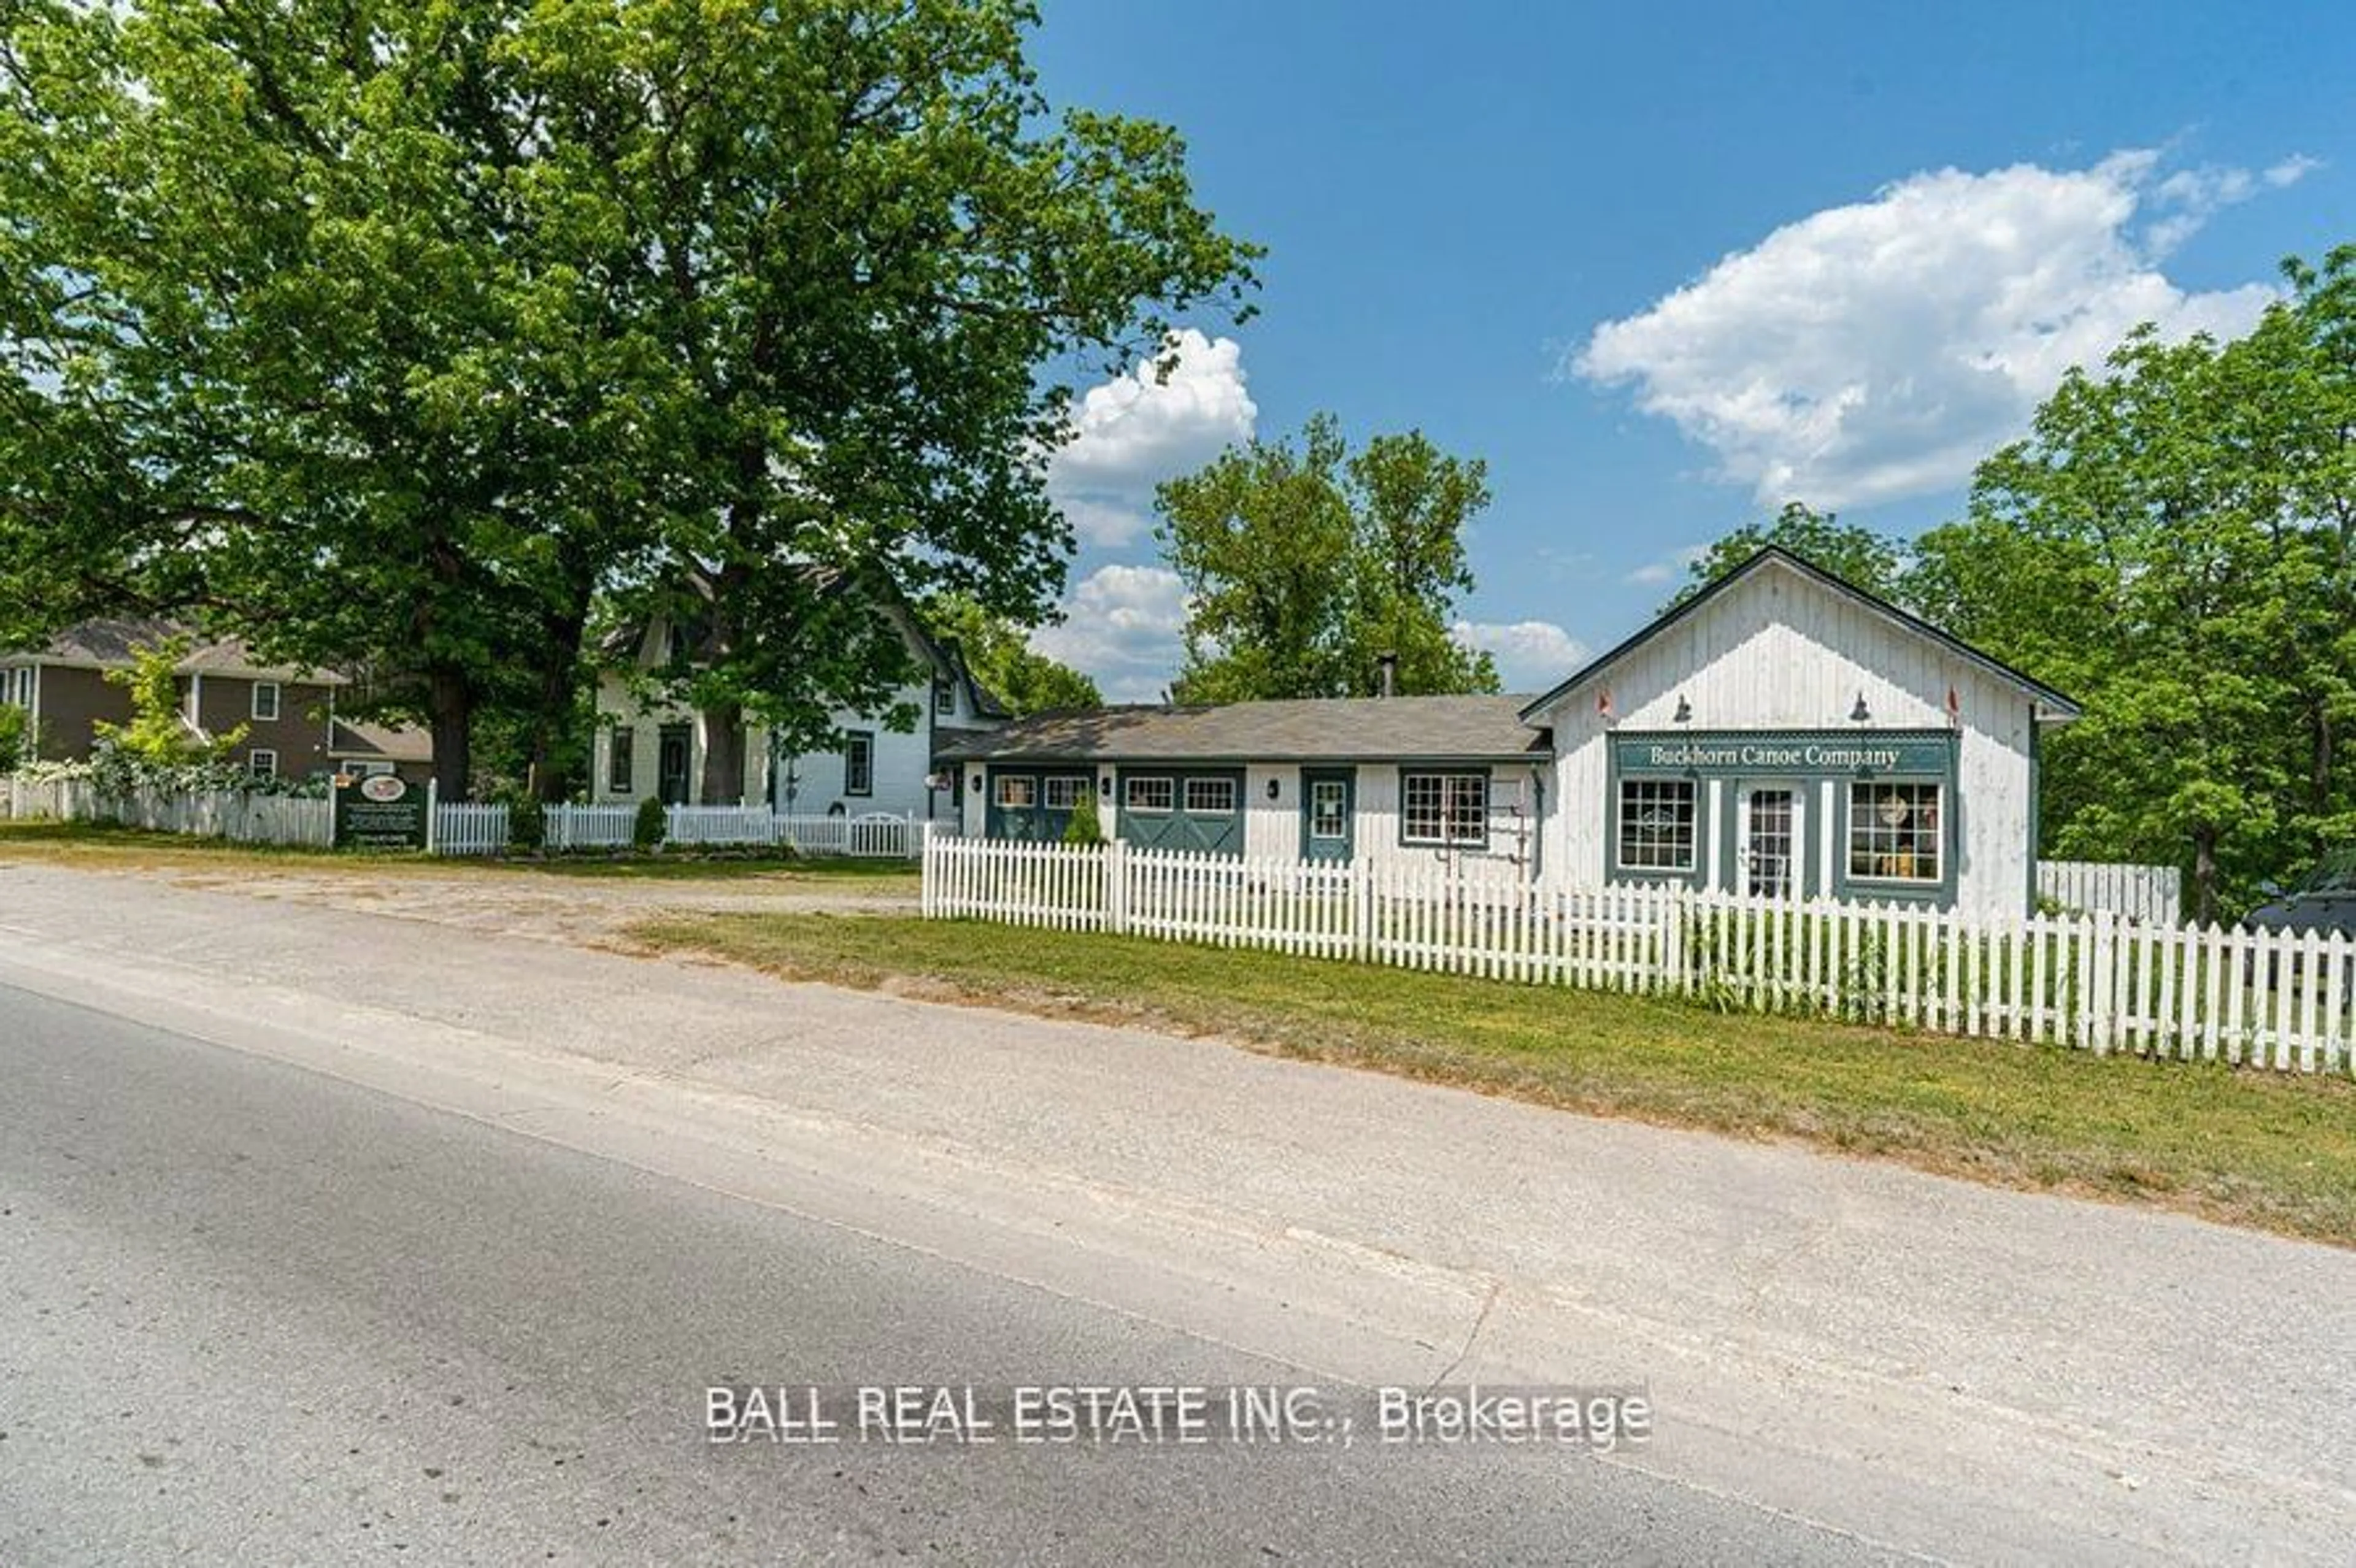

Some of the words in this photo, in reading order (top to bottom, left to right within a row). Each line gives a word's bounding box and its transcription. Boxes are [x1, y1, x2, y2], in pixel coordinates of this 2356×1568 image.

[1651, 745, 1738, 765] Buckhorn
[1741, 745, 1802, 765] Canoe
[1805, 745, 1900, 771] Company
